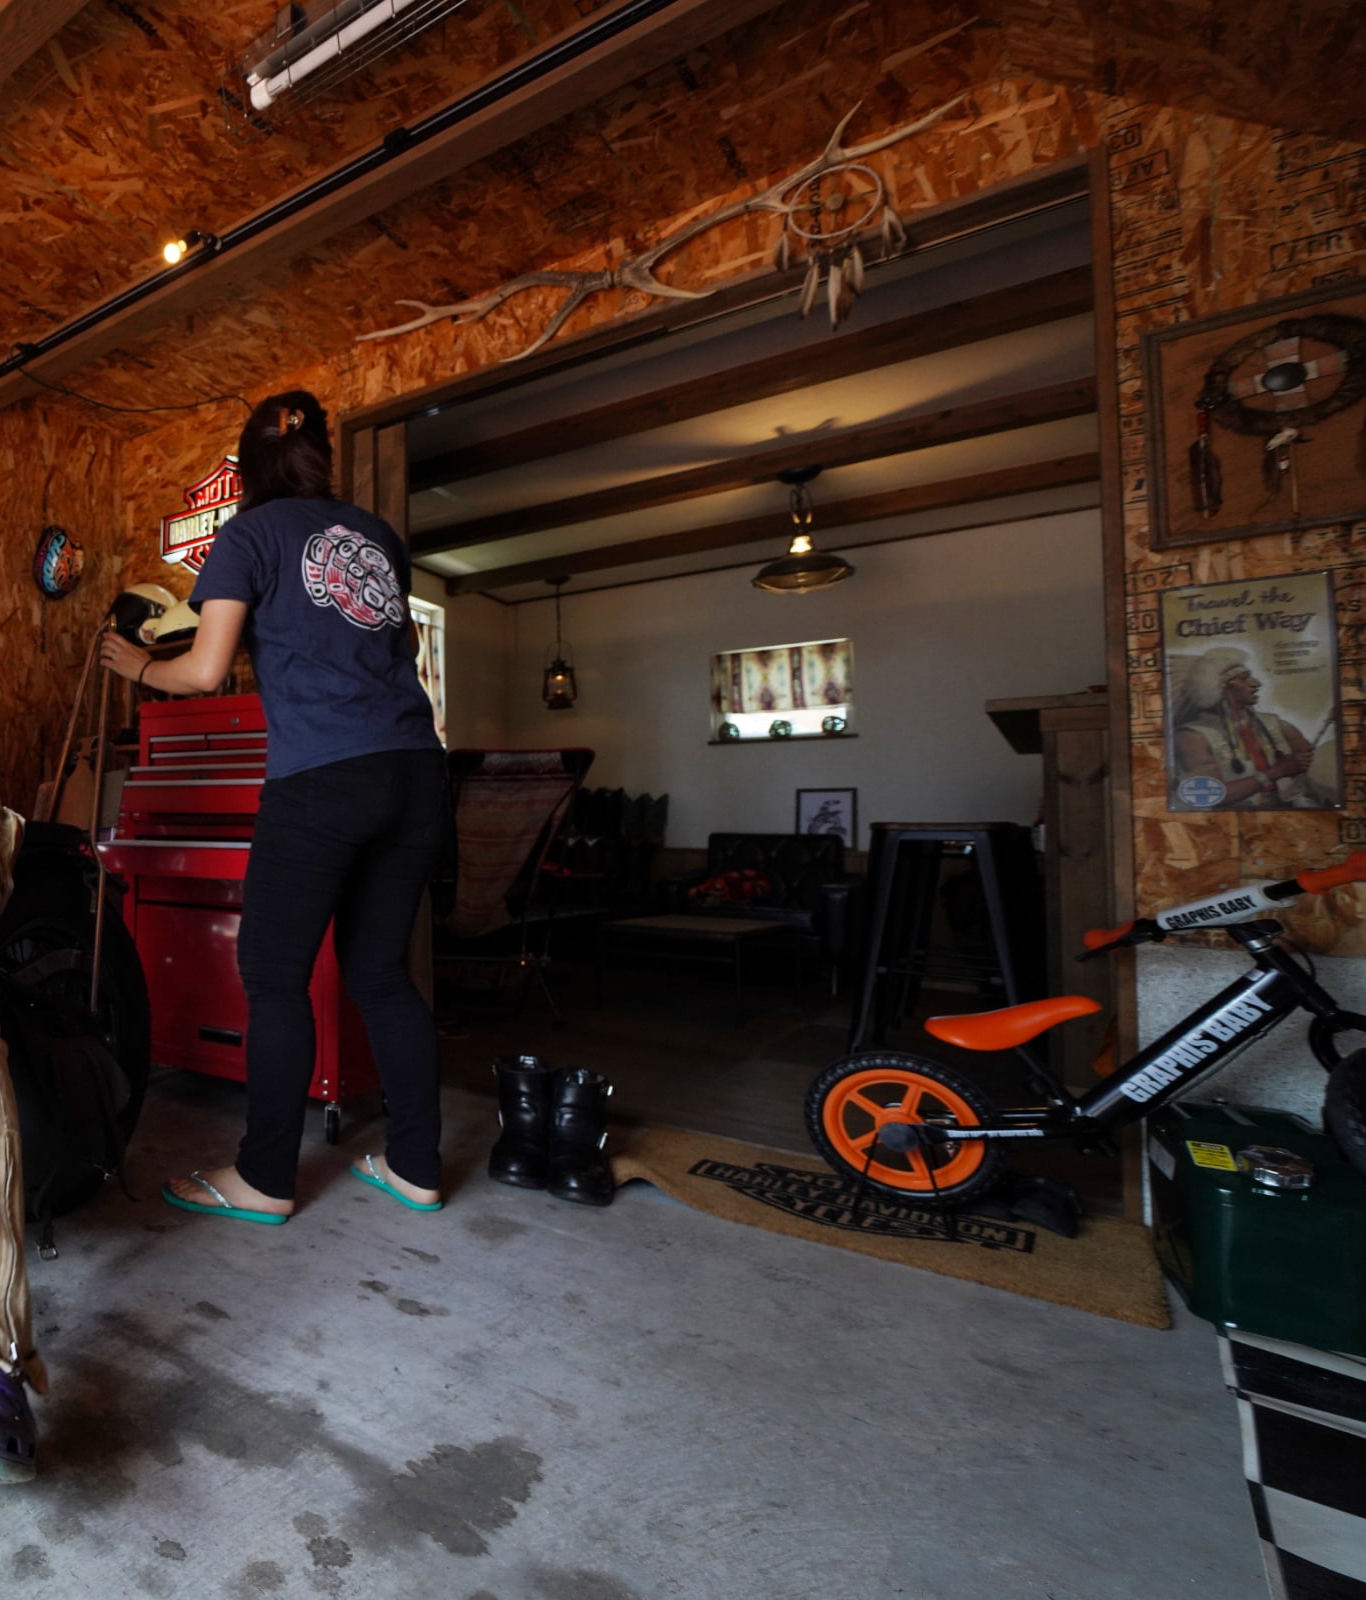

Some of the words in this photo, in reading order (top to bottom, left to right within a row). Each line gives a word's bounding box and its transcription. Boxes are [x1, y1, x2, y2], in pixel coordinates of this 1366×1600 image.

[1177, 590, 1255, 612] Travel
[1259, 586, 1295, 603] the
[1176, 614, 1248, 638] Chief
[1253, 610, 1316, 632] Way
[1165, 904, 1222, 931] GRAPHIS
[1218, 895, 1258, 917] BABY
[1119, 1033, 1219, 1104] GRAPHIS
[1205, 991, 1275, 1043] BABY
